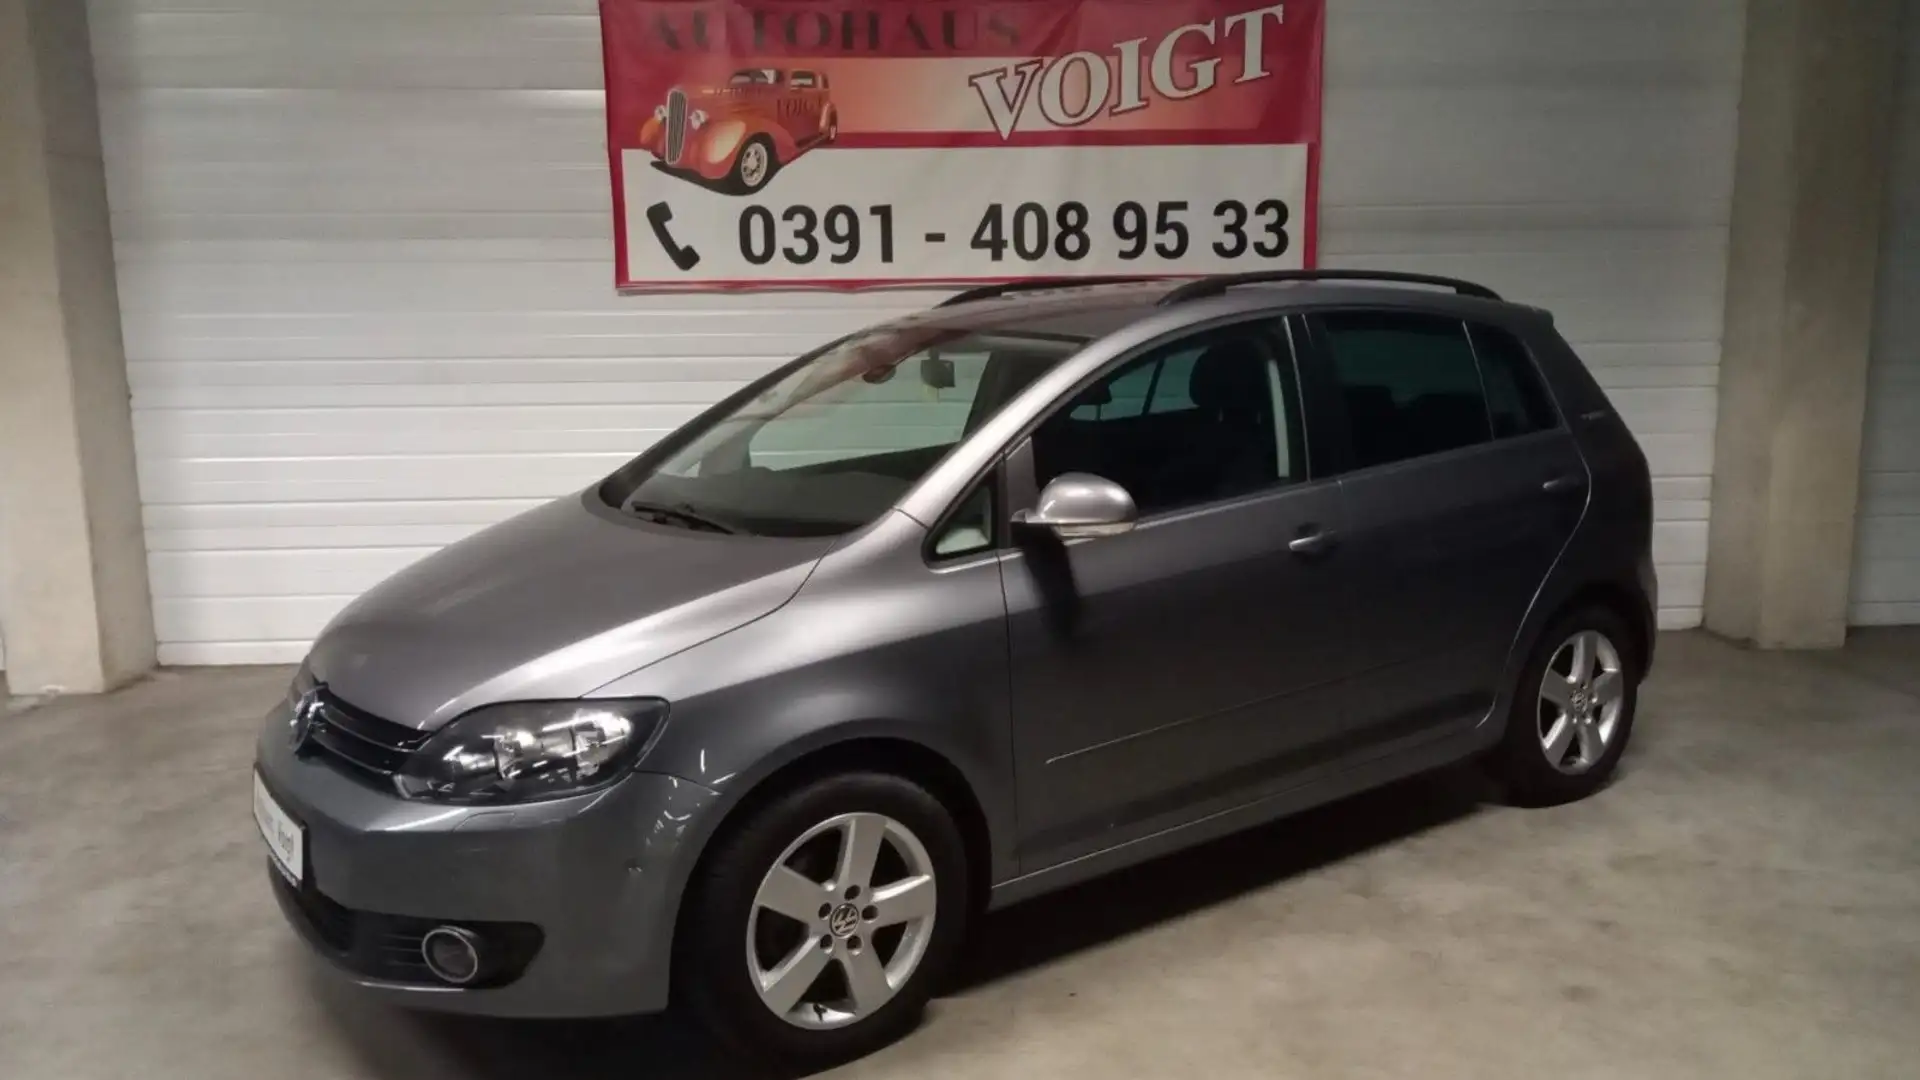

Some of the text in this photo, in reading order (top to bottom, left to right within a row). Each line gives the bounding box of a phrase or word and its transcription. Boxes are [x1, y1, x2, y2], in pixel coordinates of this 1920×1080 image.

[649, 10, 1020, 50] AUTOHAUS
[968, 4, 1284, 140] VOIGT
[738, 204, 894, 264] 0391
[970, 201, 1091, 261] 408
[1112, 201, 1190, 260] 95
[1212, 198, 1289, 259] 33
